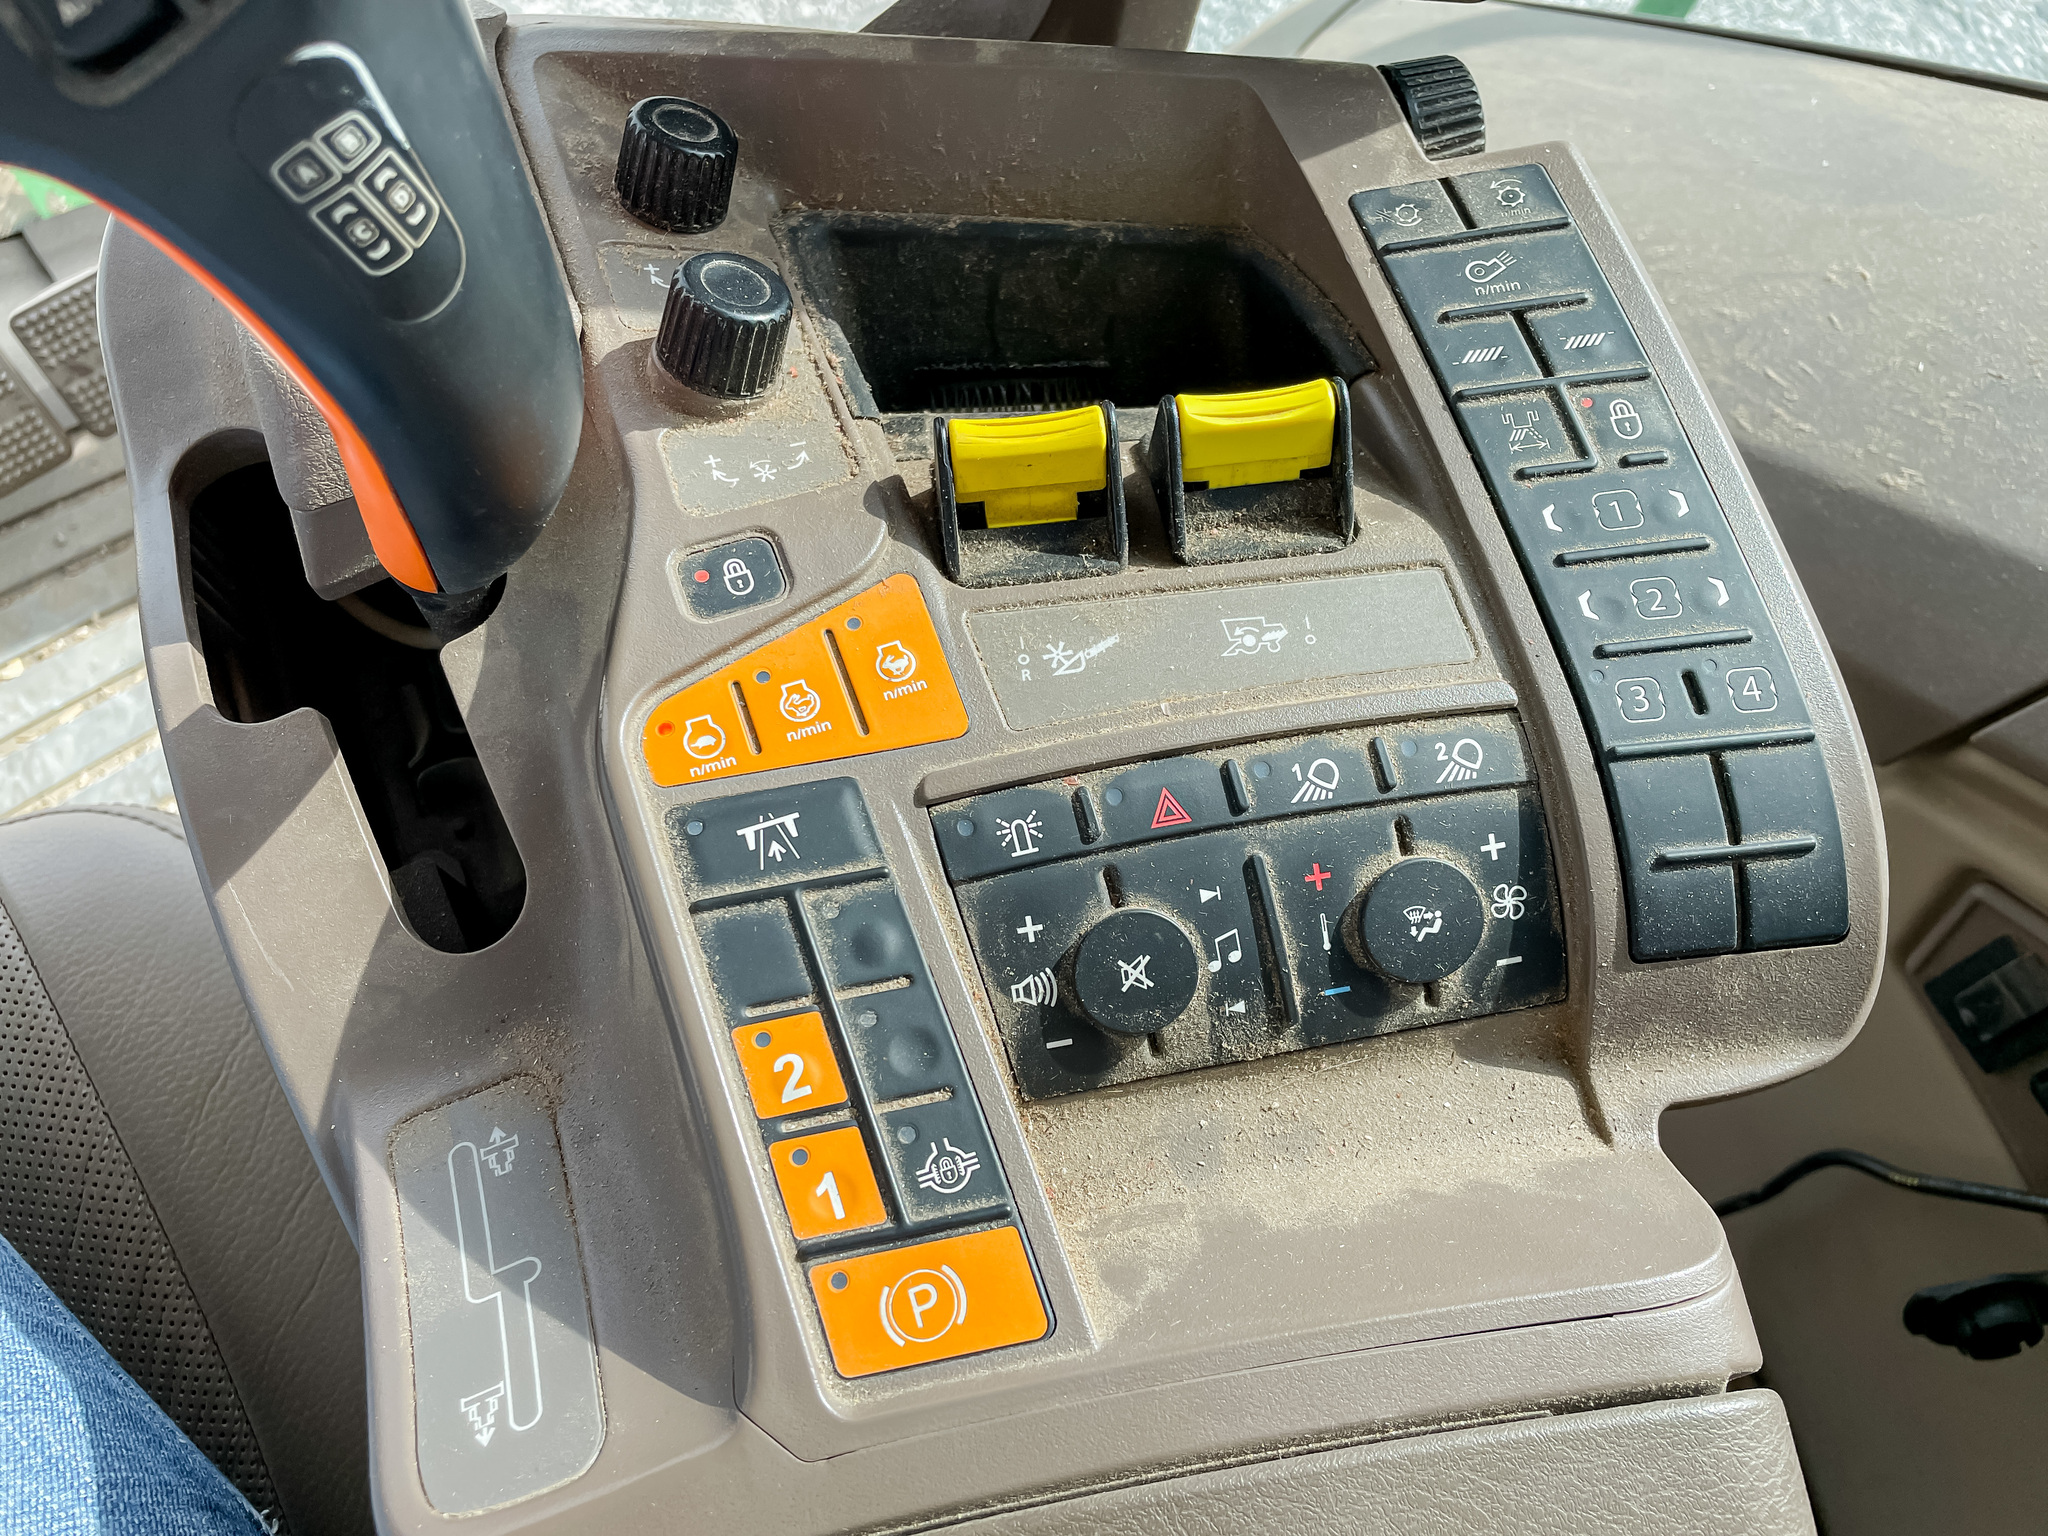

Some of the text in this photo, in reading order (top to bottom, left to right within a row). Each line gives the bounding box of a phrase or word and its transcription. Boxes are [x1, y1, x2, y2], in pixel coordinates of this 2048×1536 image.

[1474, 279, 1522, 296] n/min
[1608, 500, 1624, 522] 1
[1650, 588, 1667, 612] 2
[1021, 669, 1032, 682] R
[883, 679, 928, 702] n/min
[1631, 686, 1651, 713] 3
[1742, 676, 1762, 700] 4
[786, 718, 833, 743] n/min
[1434, 741, 1449, 762] 2
[689, 754, 737, 778] n/min
[1291, 763, 1303, 782] 1
[772, 1053, 812, 1104] 2
[815, 1172, 846, 1220] 1
[907, 1283, 938, 1328] P
